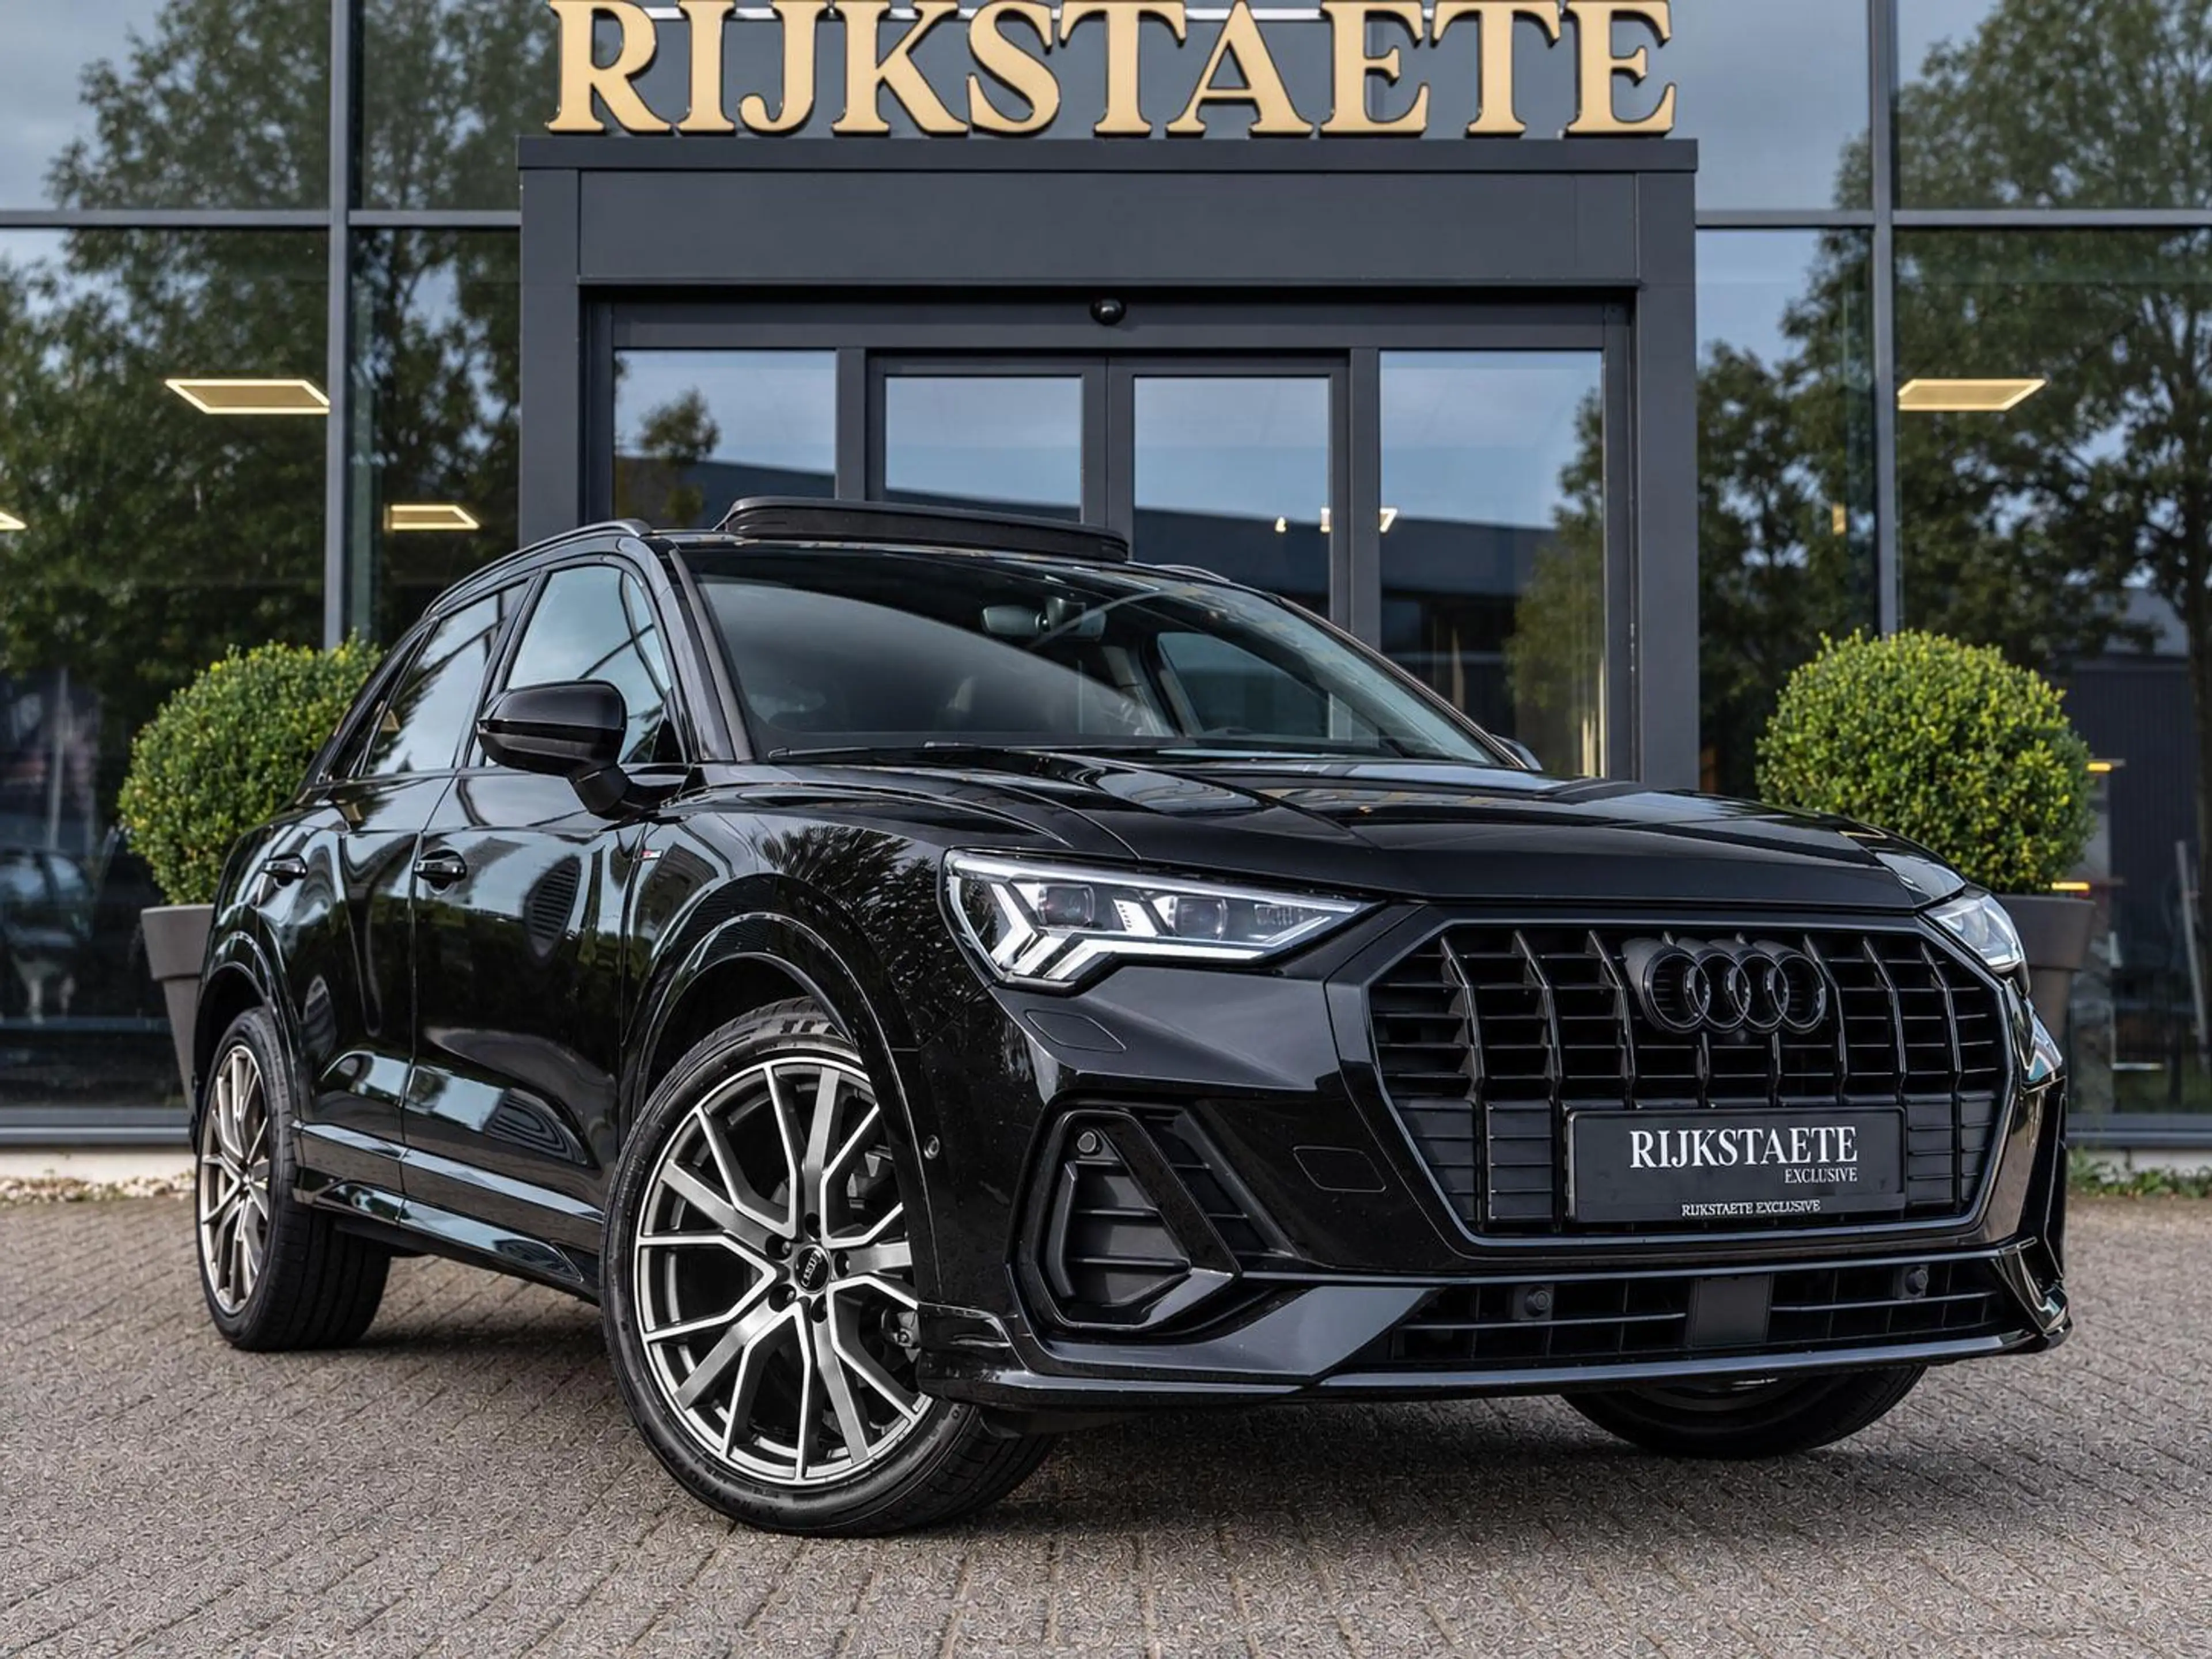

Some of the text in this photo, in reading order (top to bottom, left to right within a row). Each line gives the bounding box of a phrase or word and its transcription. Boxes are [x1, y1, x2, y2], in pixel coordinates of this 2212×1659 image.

[548, 0, 1677, 137] RIJKSTAETE
[1629, 1126, 1858, 1168] RIJKSTAETE
[1785, 1168, 1858, 1184] EXCLUSIVE
[1681, 1199, 1820, 1217] RIJKSTAETE EXCLUSIVE
